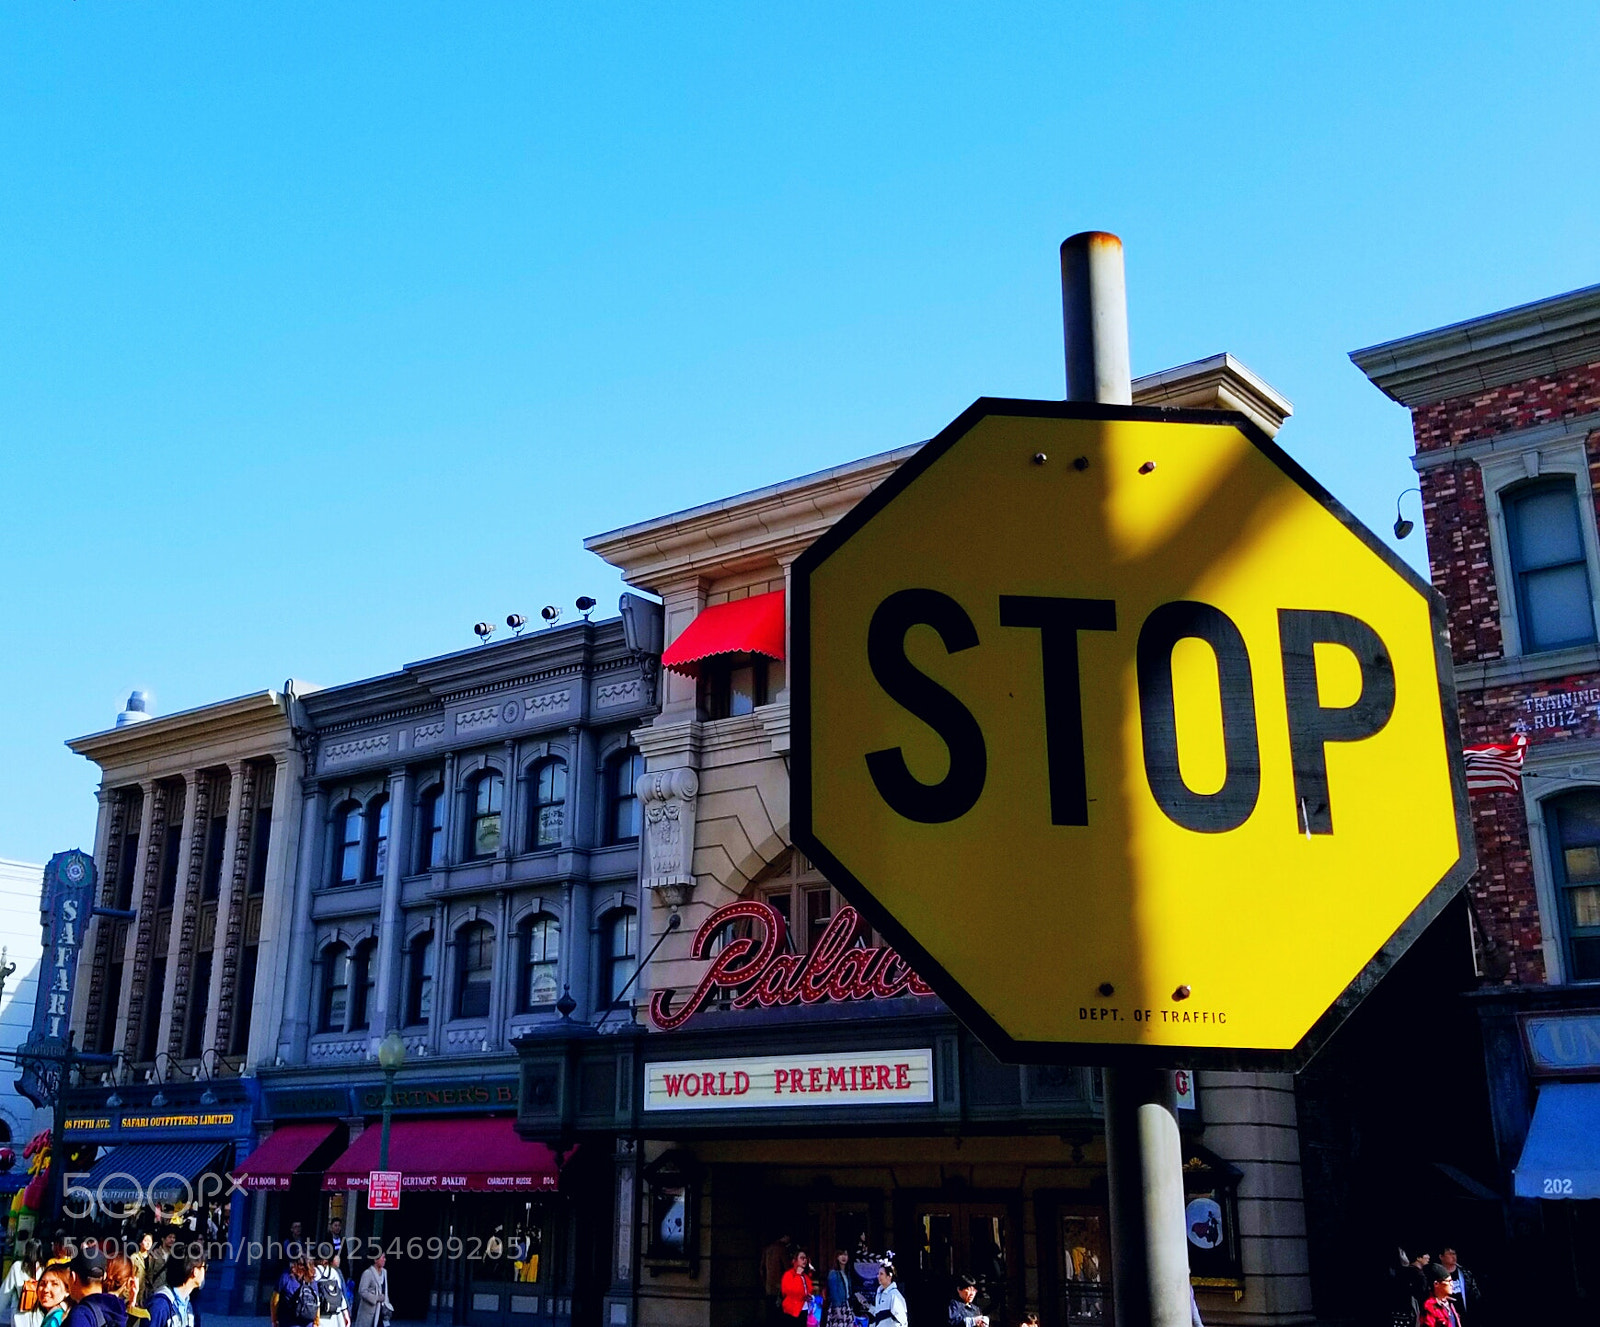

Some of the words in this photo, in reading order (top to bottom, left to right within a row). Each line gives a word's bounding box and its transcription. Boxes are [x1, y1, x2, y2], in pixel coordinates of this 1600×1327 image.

[1523, 688, 1600, 713] TRAINING
[865, 588, 1396, 836] STOP
[51, 899, 78, 1038] SAFARI
[1079, 1007, 1124, 1021] DEPT.
[1133, 1009, 1151, 1022] OF
[1160, 1010, 1227, 1024] TRAFFIC
[663, 1070, 750, 1098] WORLD
[774, 1063, 912, 1093] PREMIERE
[73, 1119, 95, 1129] FIFTH
[121, 1117, 149, 1128] SAFARI
[150, 1115, 199, 1126] OUTFITTERS
[200, 1114, 234, 1125] LIMITED
[259, 1177, 276, 1185] ROOM
[402, 1176, 437, 1186] GERTNER'S
[441, 1176, 467, 1186] BAKERY
[487, 1177, 514, 1185] CHARLOTTE
[1544, 1179, 1572, 1194] 202
